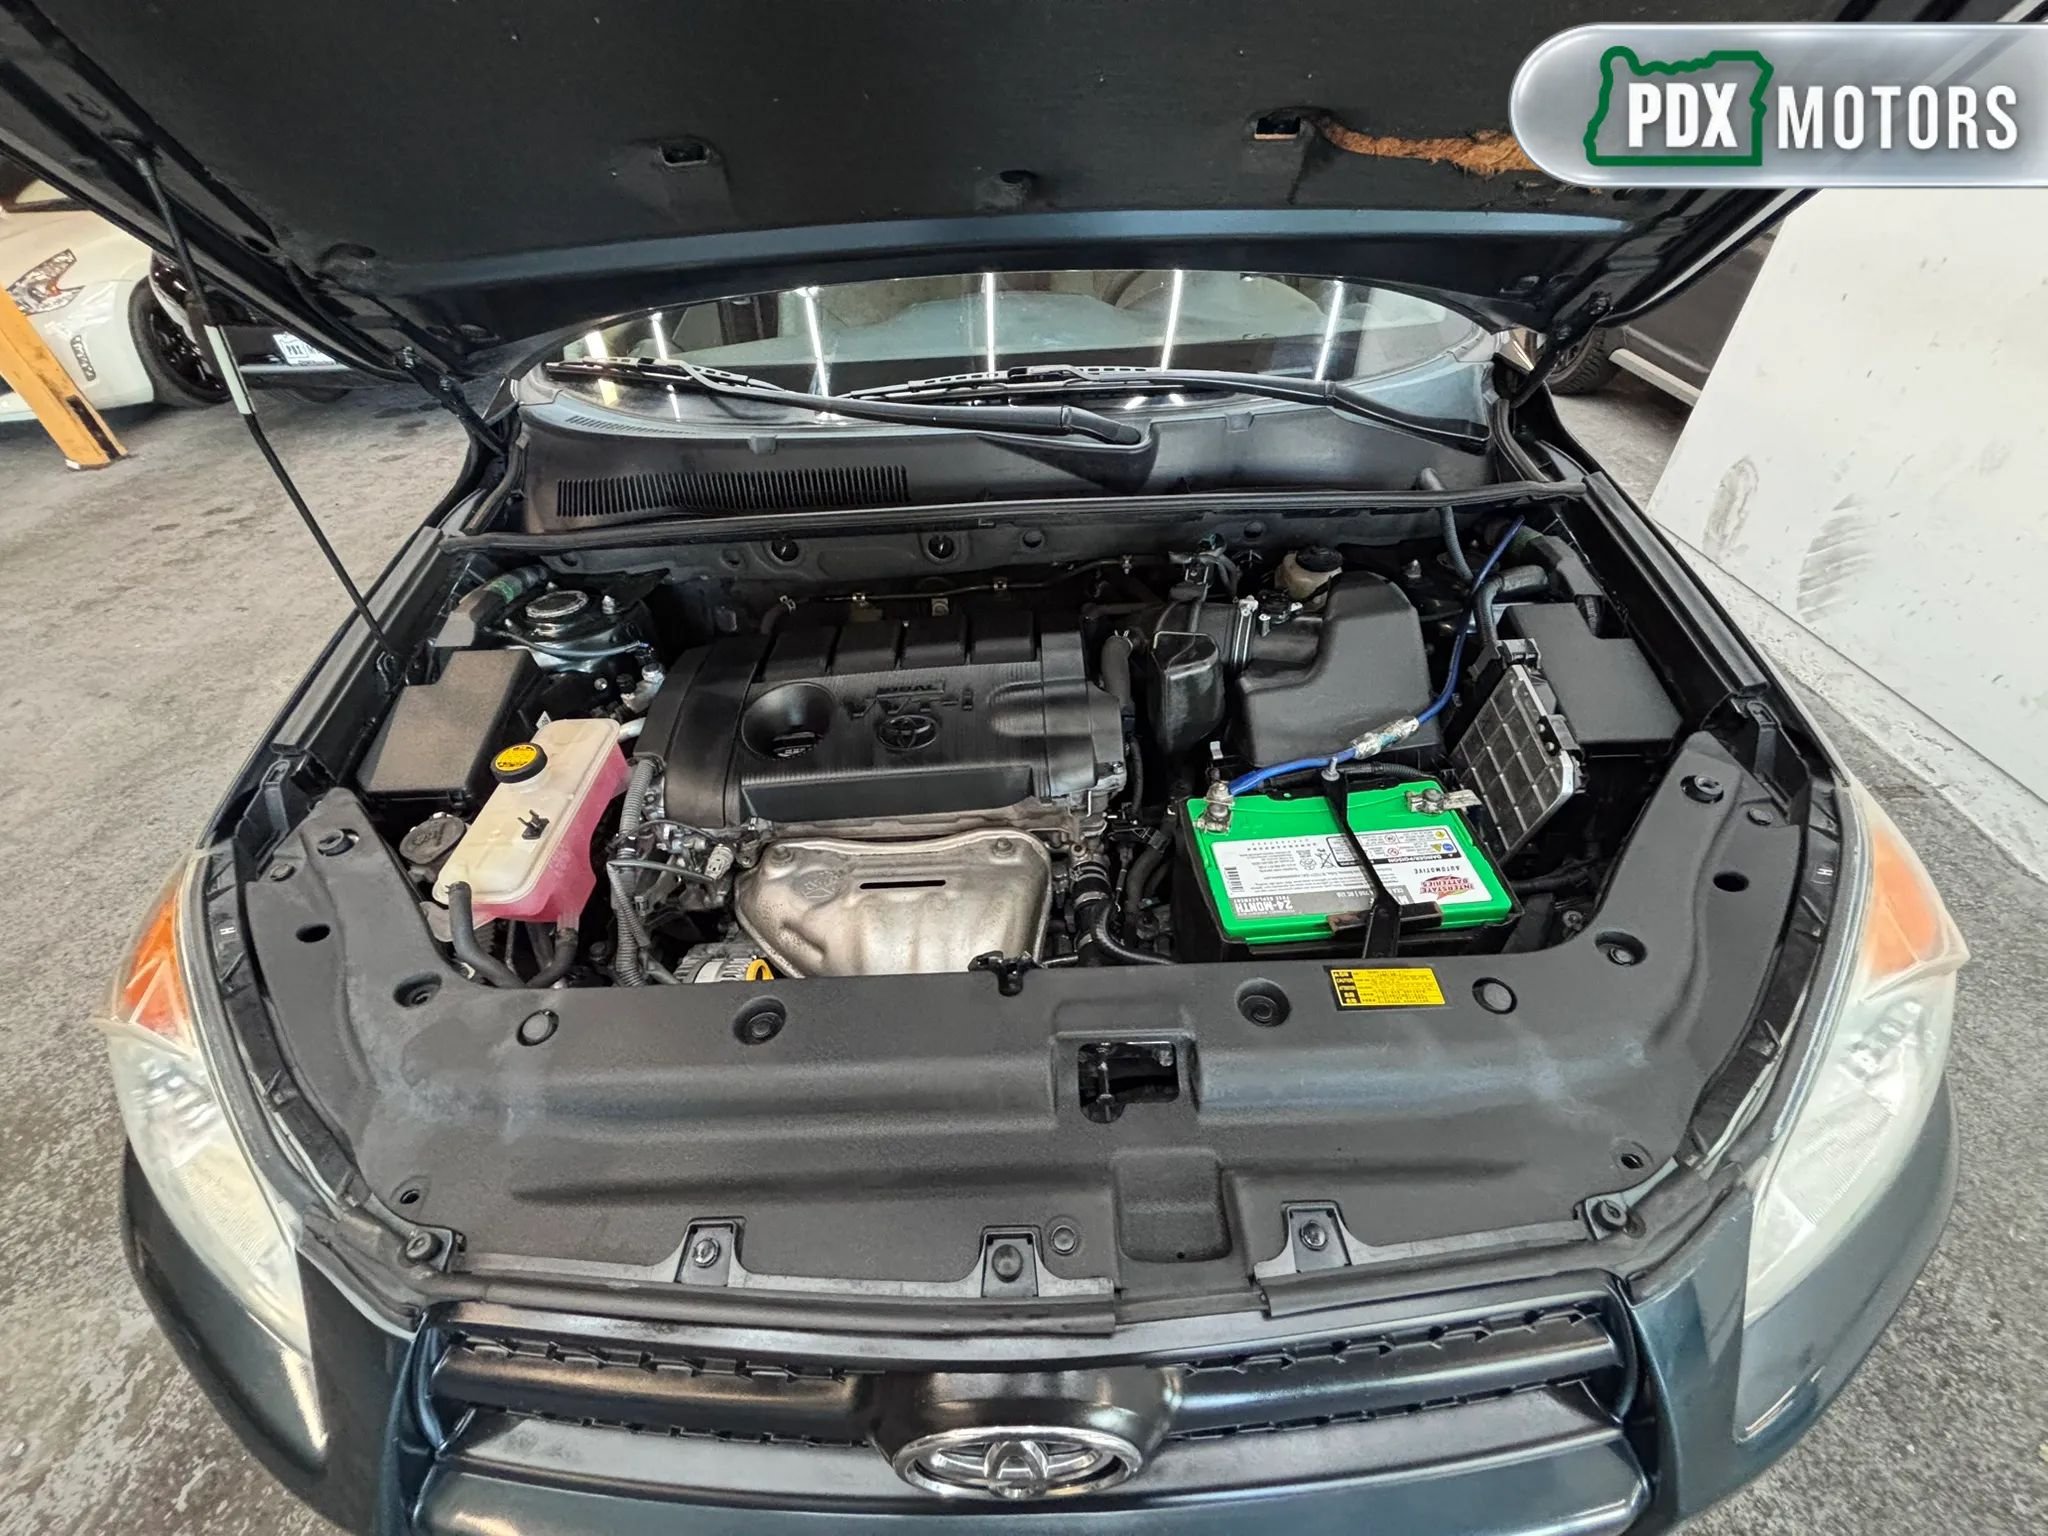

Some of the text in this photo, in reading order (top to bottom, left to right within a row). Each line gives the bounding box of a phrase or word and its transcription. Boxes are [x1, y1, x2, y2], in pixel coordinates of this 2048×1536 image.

[1413, 865, 1461, 875] AUTOMOTIVE
[1419, 883, 1475, 895] INTERSTATE
[1421, 877, 1469, 889] BATTERIES
[1234, 900, 1293, 913] 24-MONTH
